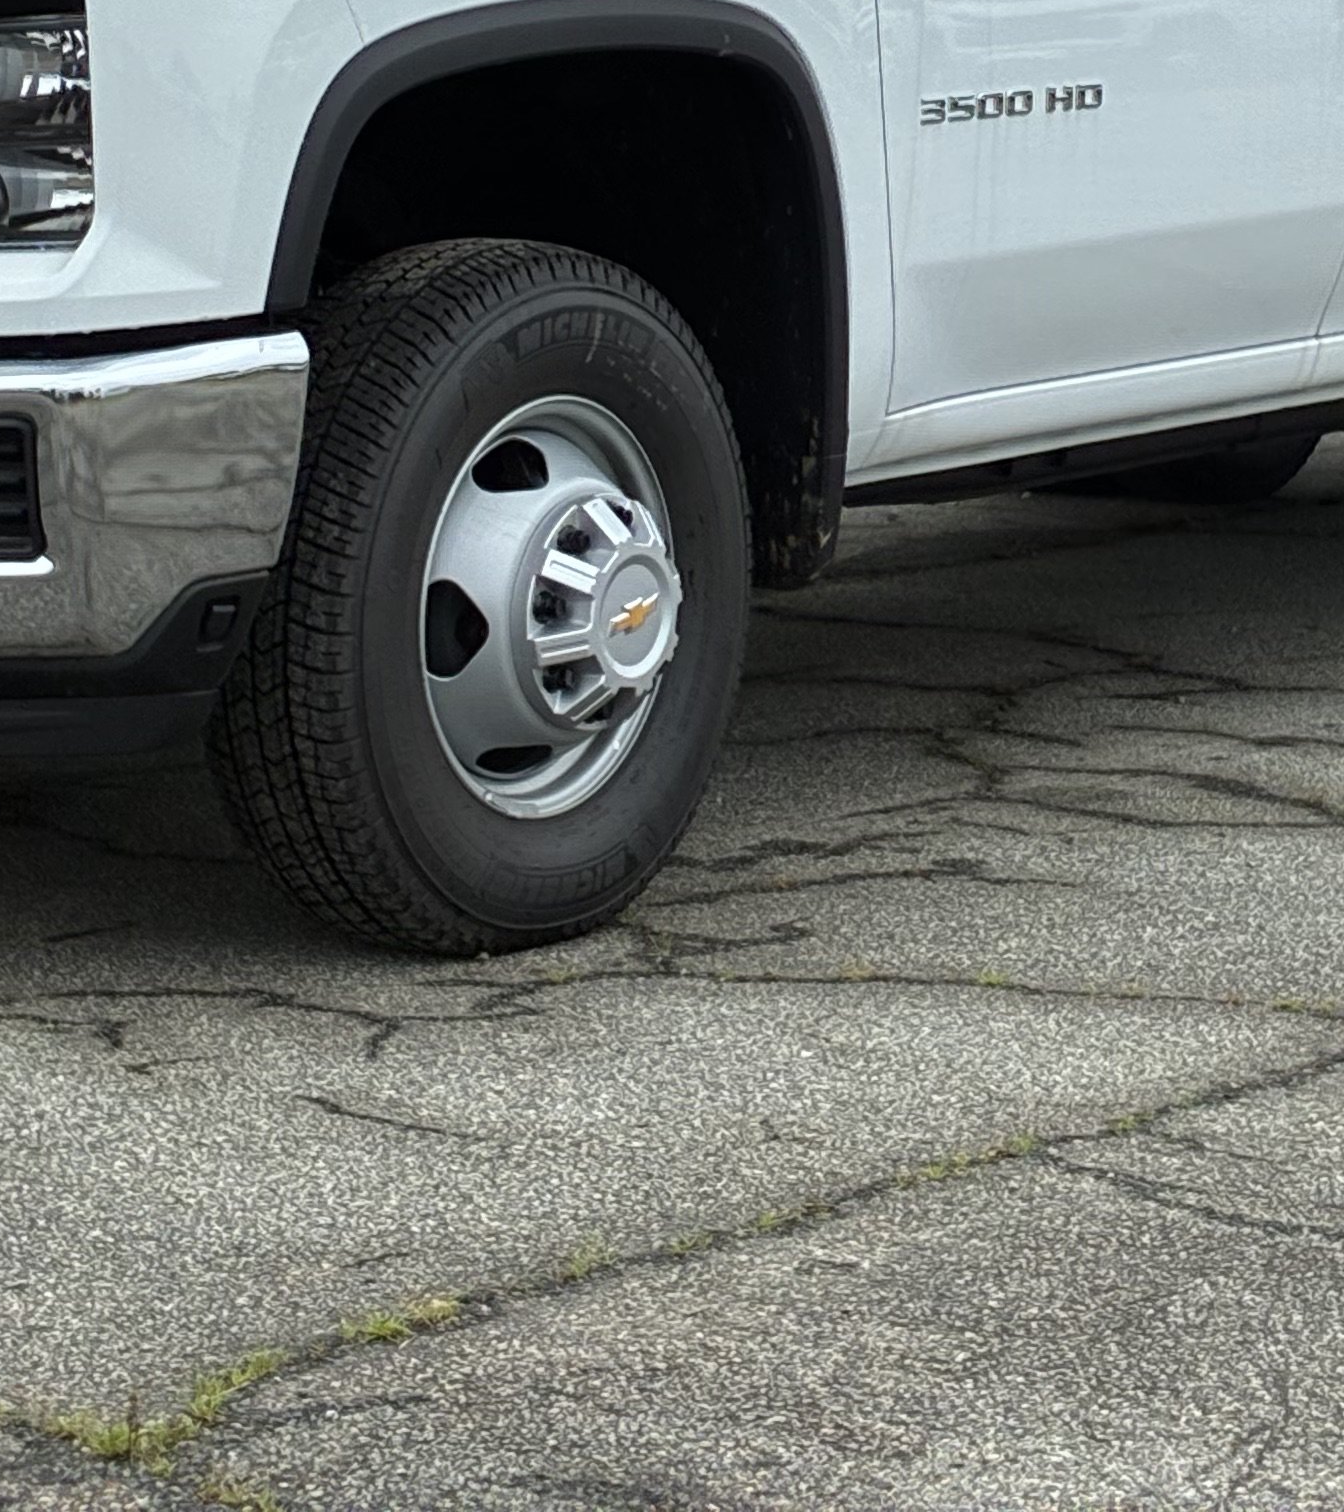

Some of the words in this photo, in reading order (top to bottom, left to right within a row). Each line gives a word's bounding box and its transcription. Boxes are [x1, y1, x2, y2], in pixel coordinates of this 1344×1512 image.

[919, 90, 1034, 126] 3500
[1045, 83, 1104, 114] HD
[516, 309, 650, 359] MICHELIN
